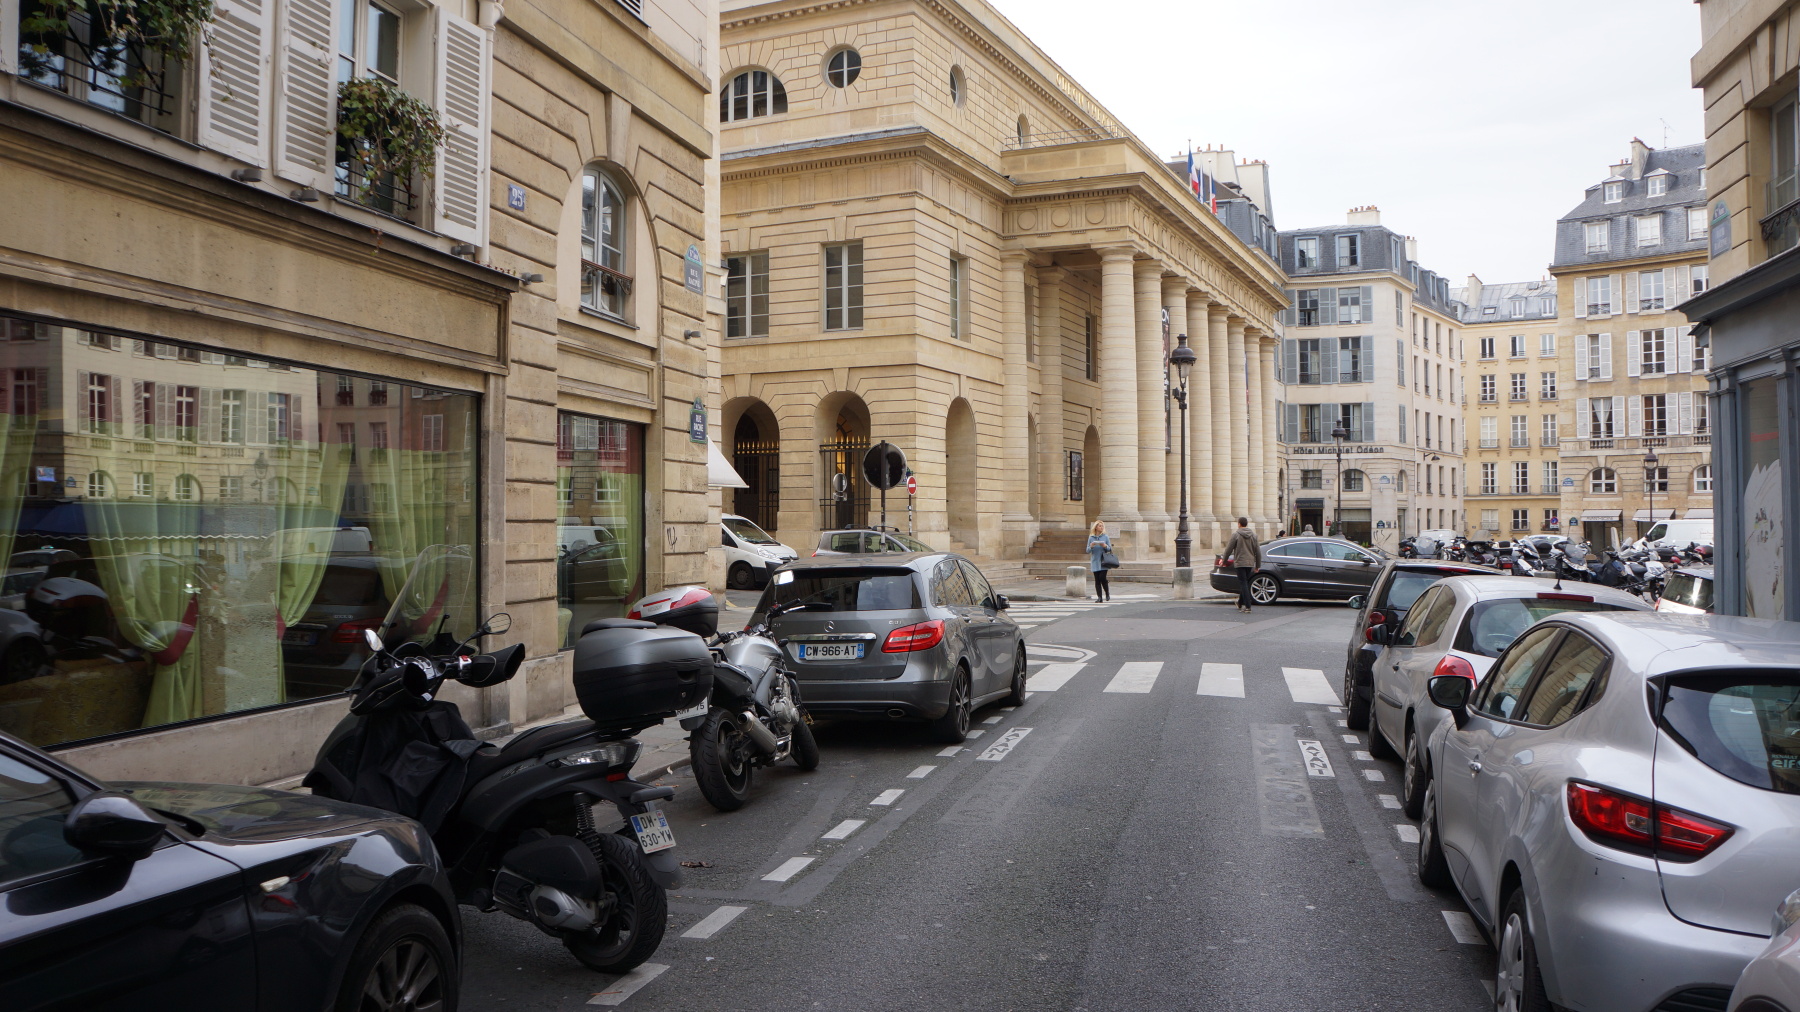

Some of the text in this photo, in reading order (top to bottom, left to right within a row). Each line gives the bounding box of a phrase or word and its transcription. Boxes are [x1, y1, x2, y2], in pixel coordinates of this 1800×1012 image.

[511, 188, 523, 207] 25
[1293, 446, 1315, 454] Hôtel
[1356, 445, 1385, 453] Odéon
[805, 646, 857, 656] CW-966-AT
[1771, 759, 1796, 769] elf
